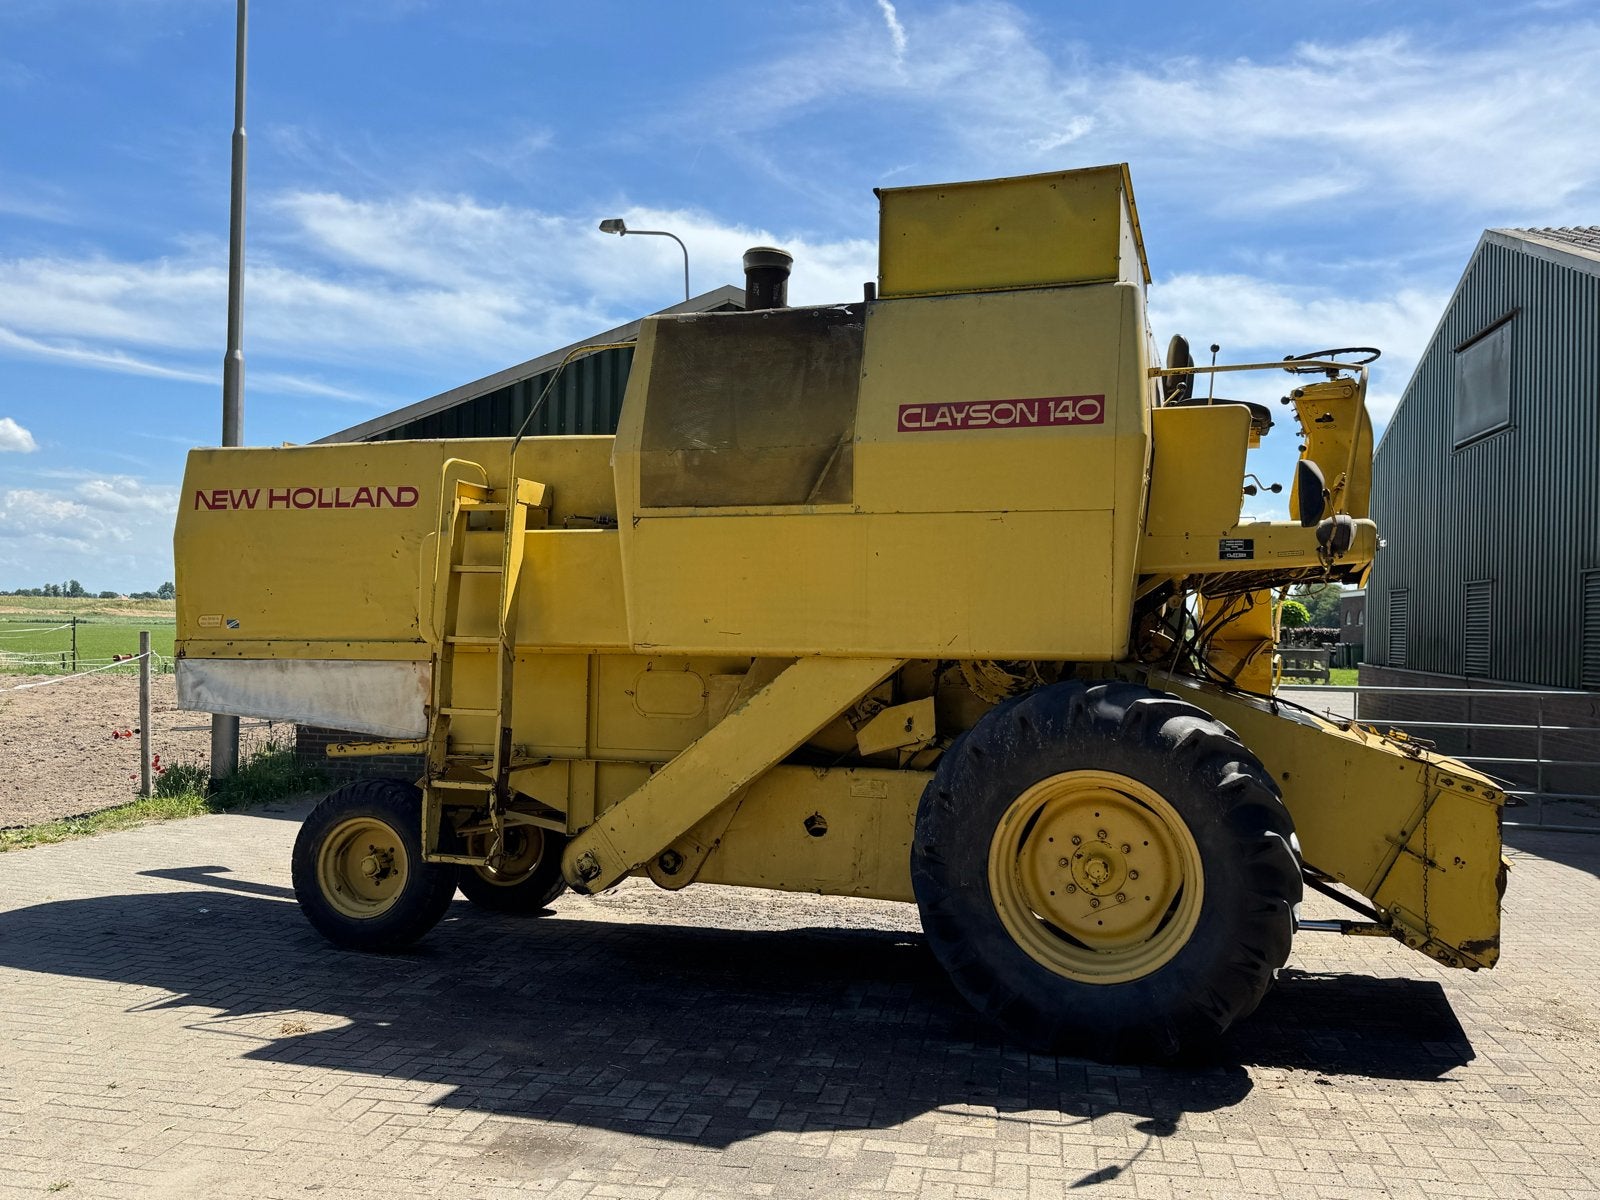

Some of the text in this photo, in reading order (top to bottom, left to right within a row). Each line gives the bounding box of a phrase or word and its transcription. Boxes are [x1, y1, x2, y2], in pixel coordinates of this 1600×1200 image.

[902, 399, 1101, 428] CLAYSON 140
[195, 486, 419, 510] NEW HOLLAND
